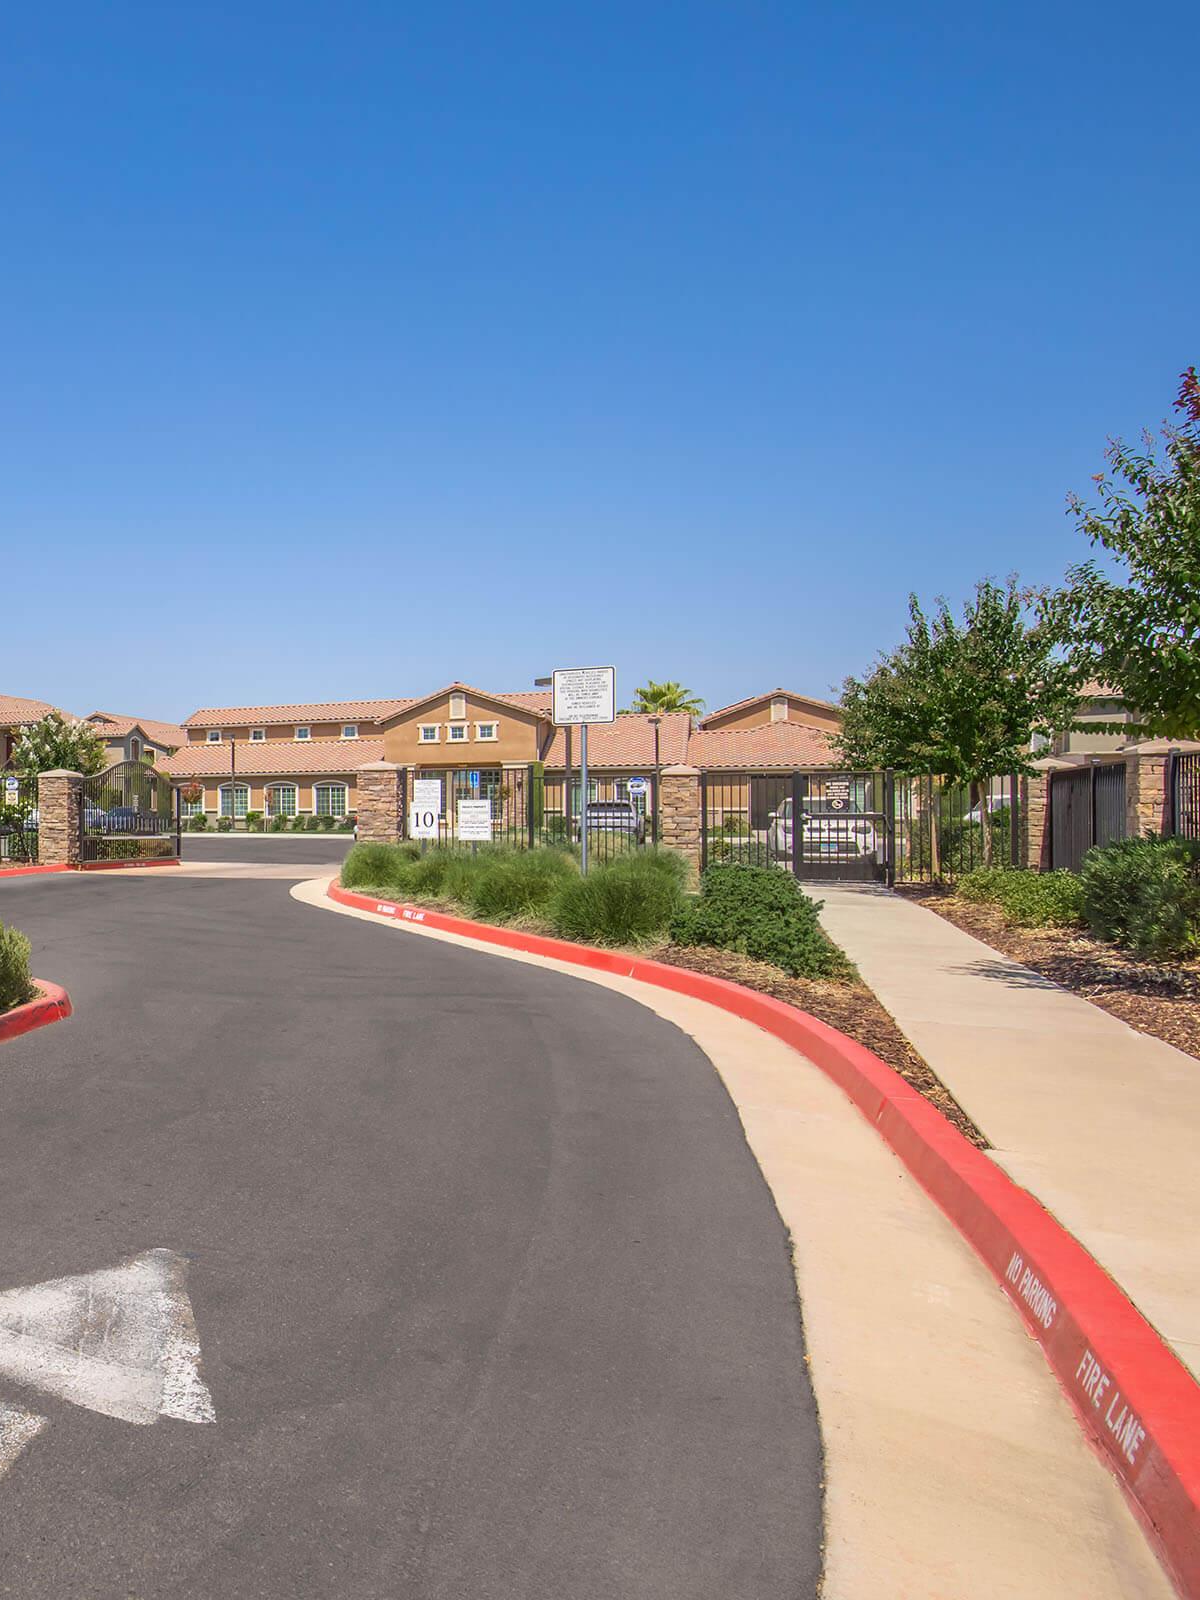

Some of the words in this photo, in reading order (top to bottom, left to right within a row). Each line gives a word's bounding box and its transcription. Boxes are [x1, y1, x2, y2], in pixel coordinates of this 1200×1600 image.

[414, 811, 434, 828] 10
[1005, 1251, 1024, 1283] NO
[1018, 1266, 1058, 1329] PARKING
[1075, 1349, 1111, 1408] FIRE
[1105, 1391, 1147, 1465] LANE
